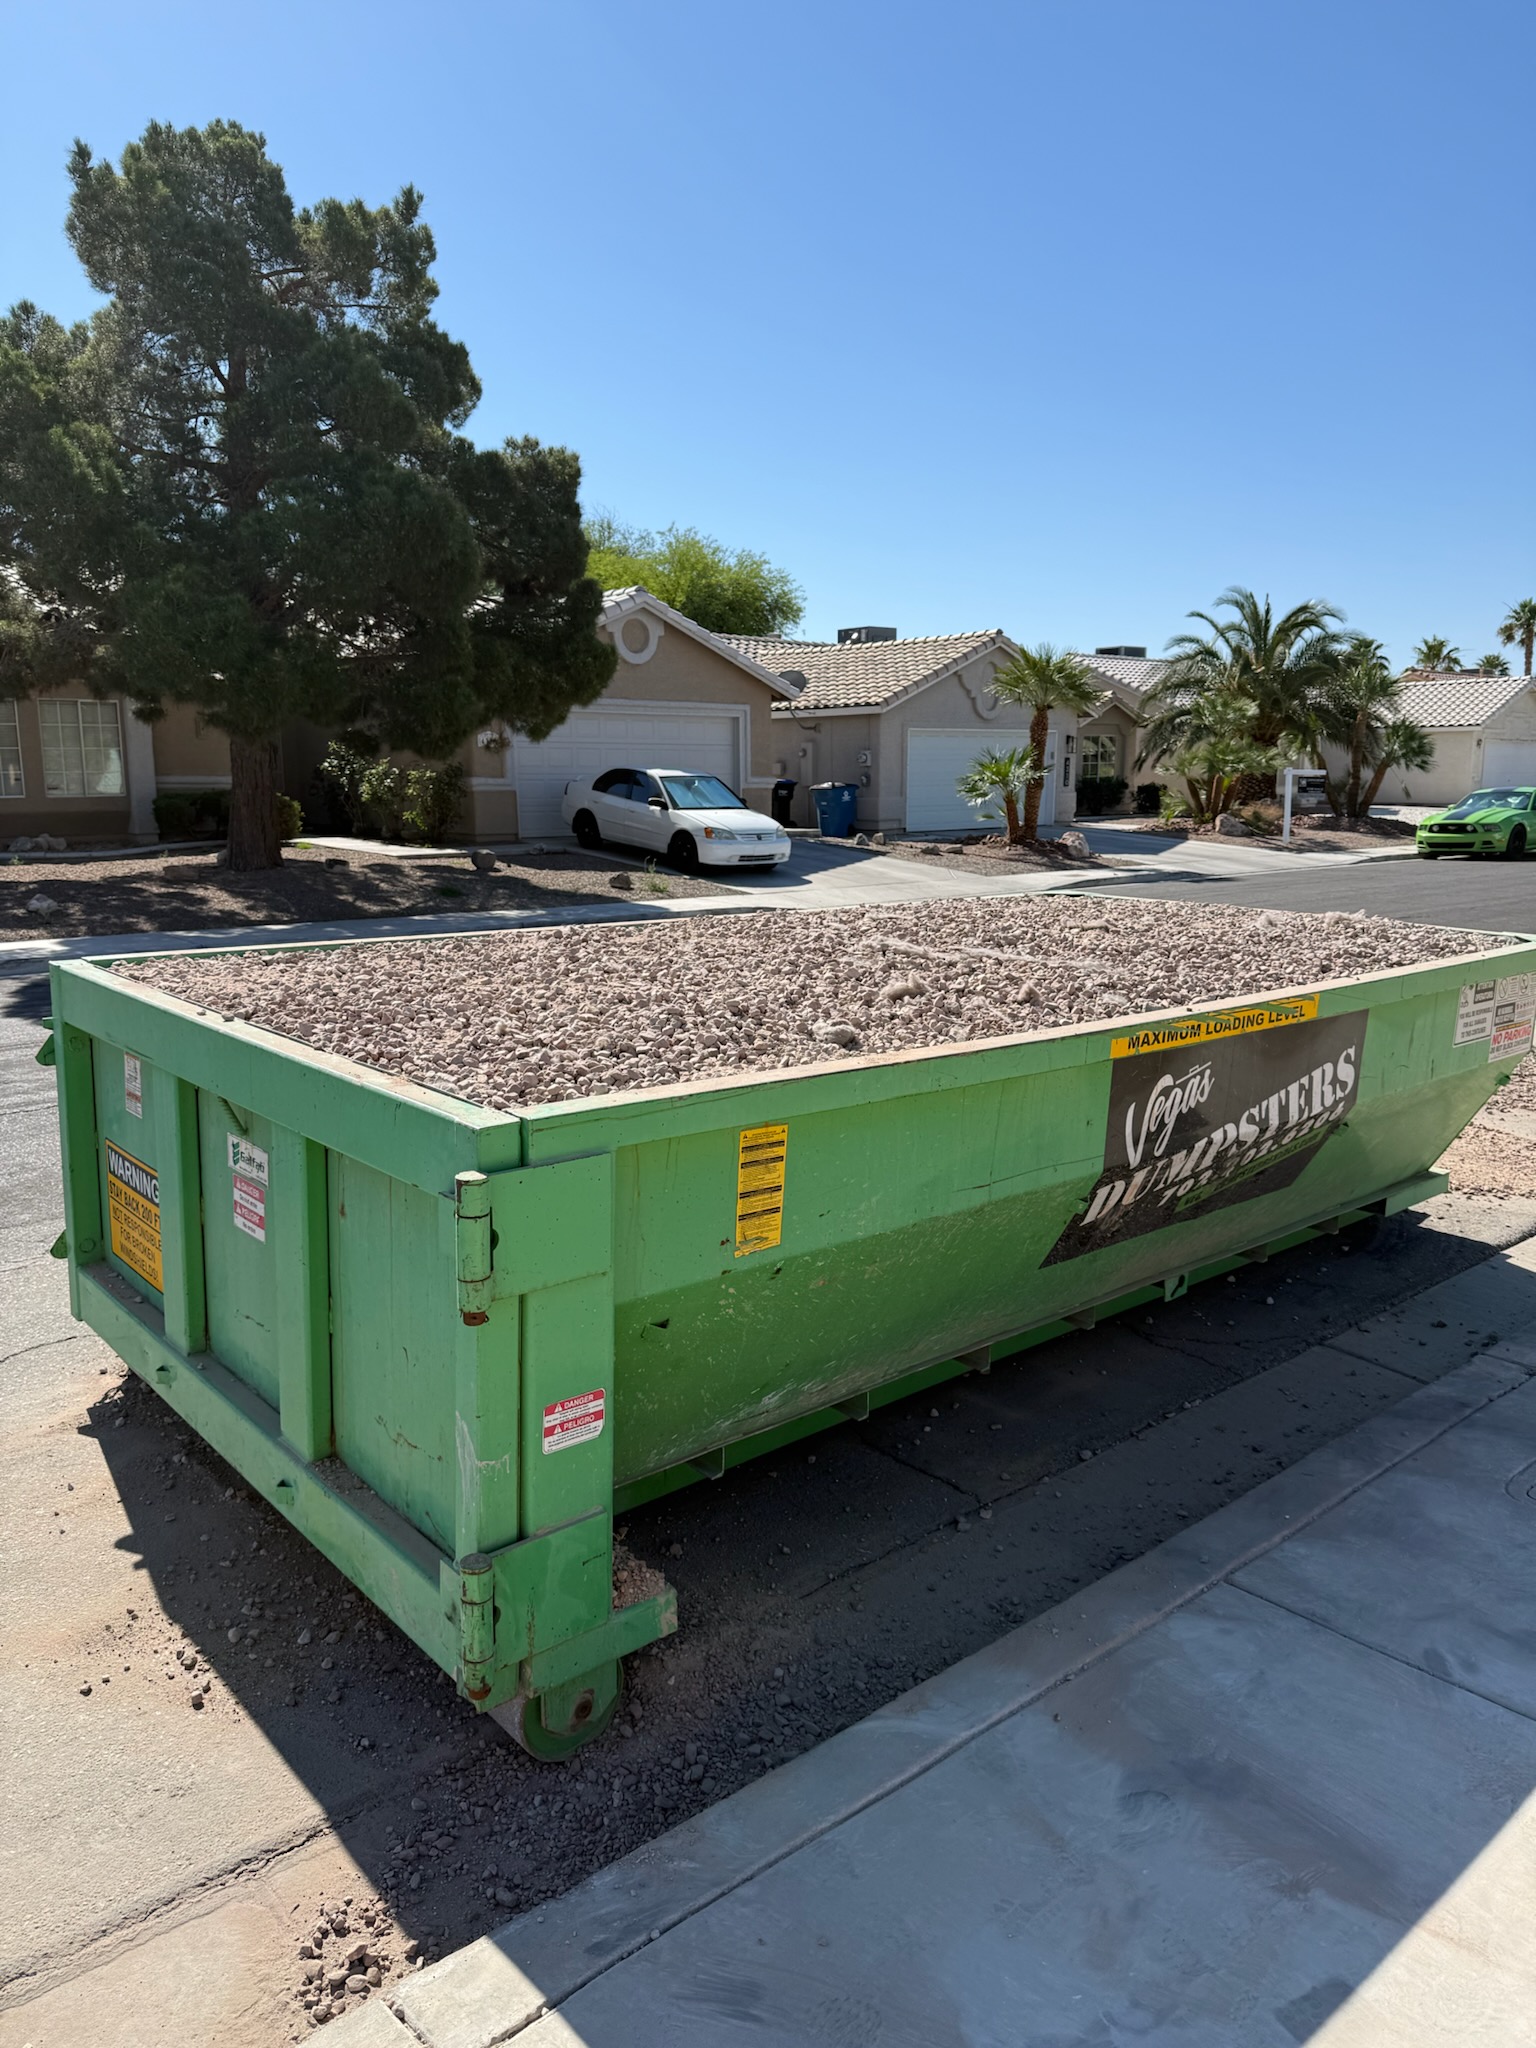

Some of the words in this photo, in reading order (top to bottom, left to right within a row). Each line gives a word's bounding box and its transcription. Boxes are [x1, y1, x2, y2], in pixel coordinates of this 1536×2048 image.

[1128, 1024, 1200, 1049] MAXIMUM
[1205, 1013, 1264, 1036] LOADING
[1269, 1005, 1306, 1024] LEVEL
[1491, 1032, 1502, 1046] NO
[1503, 1024, 1532, 1043] PARKING
[1080, 1045, 1356, 1227] DUMPSTERS
[1125, 1067, 1215, 1170] Vegas
[108, 1148, 160, 1204] WARNING
[109, 1180, 123, 1201] STAY
[124, 1190, 141, 1217] BACK
[141, 1203, 153, 1225] 200
[112, 1203, 123, 1222] NOT
[123, 1212, 162, 1252] RESPONSIBLE
[120, 1225, 132, 1246] FOR
[131, 1235, 156, 1264] BROKEN
[563, 1394, 594, 1409] DANGER
[563, 1414, 595, 1430] PELIGRO
